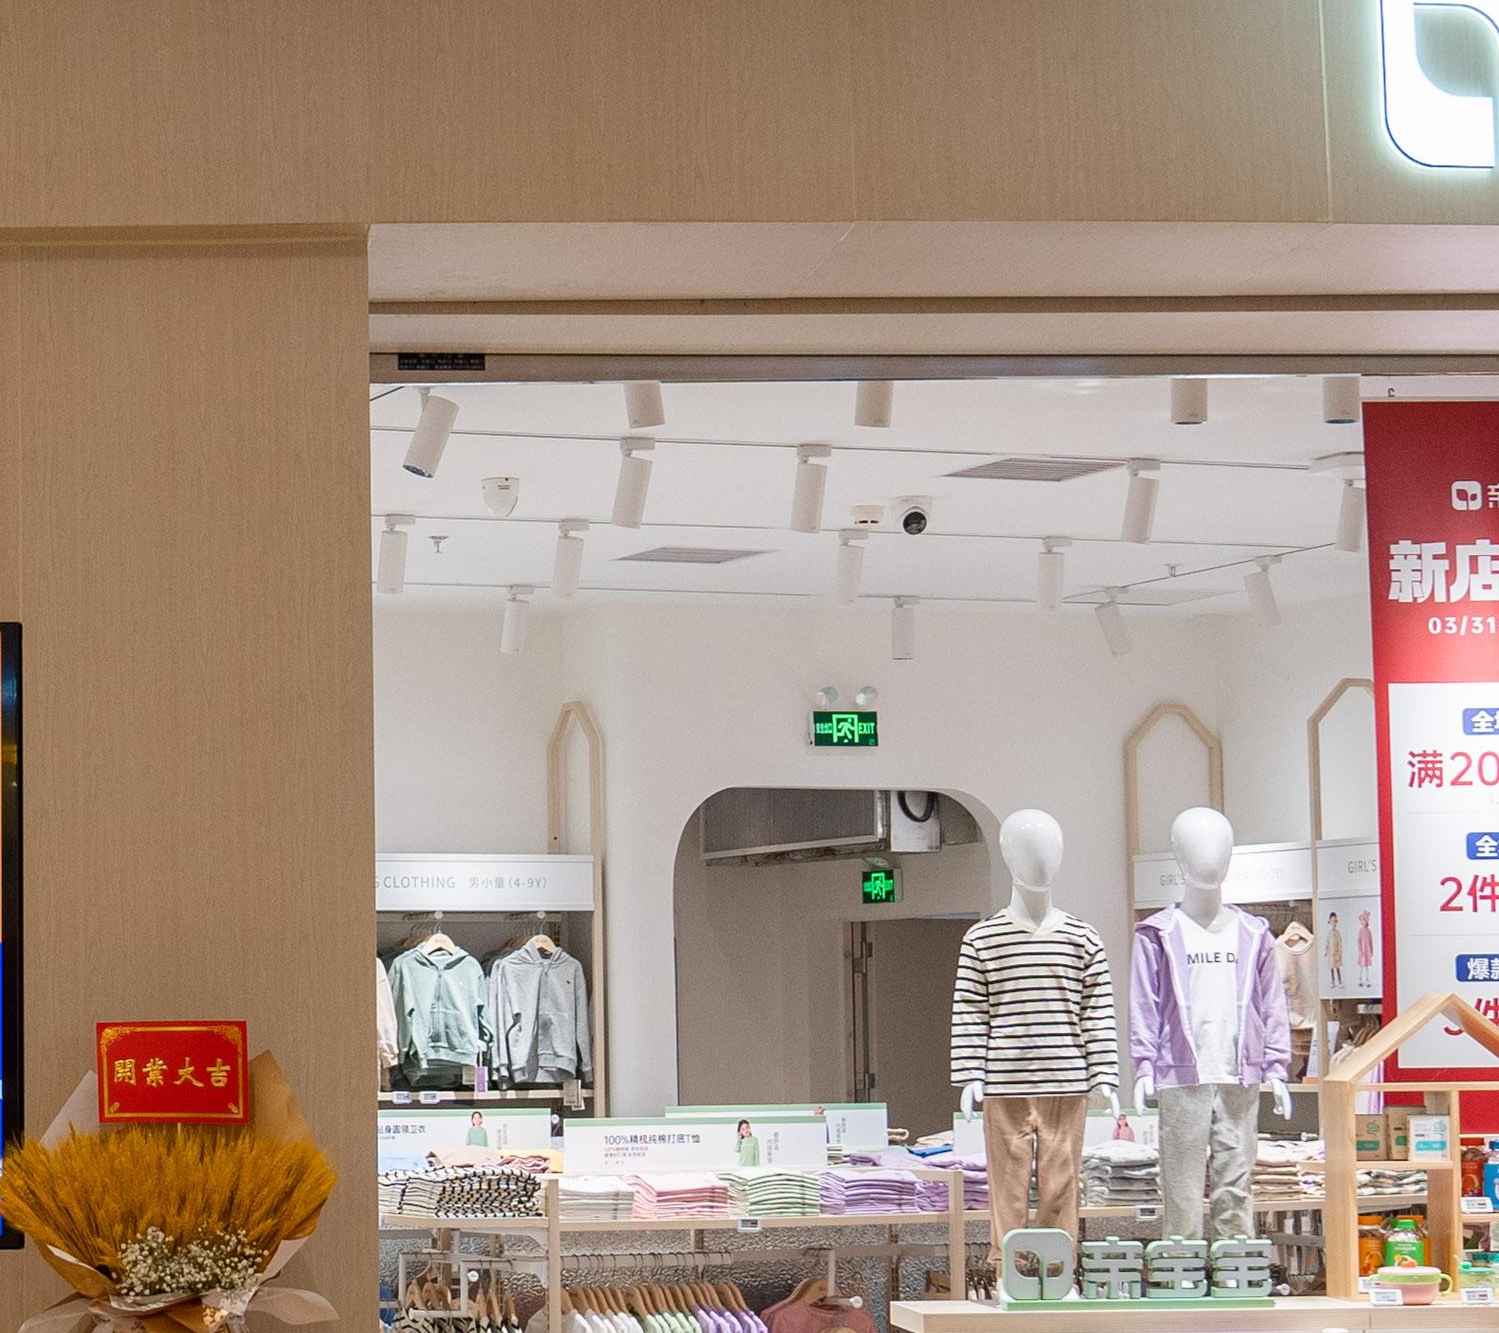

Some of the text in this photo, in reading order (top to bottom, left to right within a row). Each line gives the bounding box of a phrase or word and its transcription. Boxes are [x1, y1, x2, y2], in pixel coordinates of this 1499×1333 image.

[858, 722, 875, 735] EXIT
[1347, 858, 1378, 875] GIRL'S
[382, 875, 457, 889] CLOTHING
[1160, 874, 1187, 887] GIRL'S
[1186, 952, 1222, 966] MILE
[113, 1056, 232, 1088] 開業大吉
[1081, 1234, 1273, 1299] 亲宝宝
